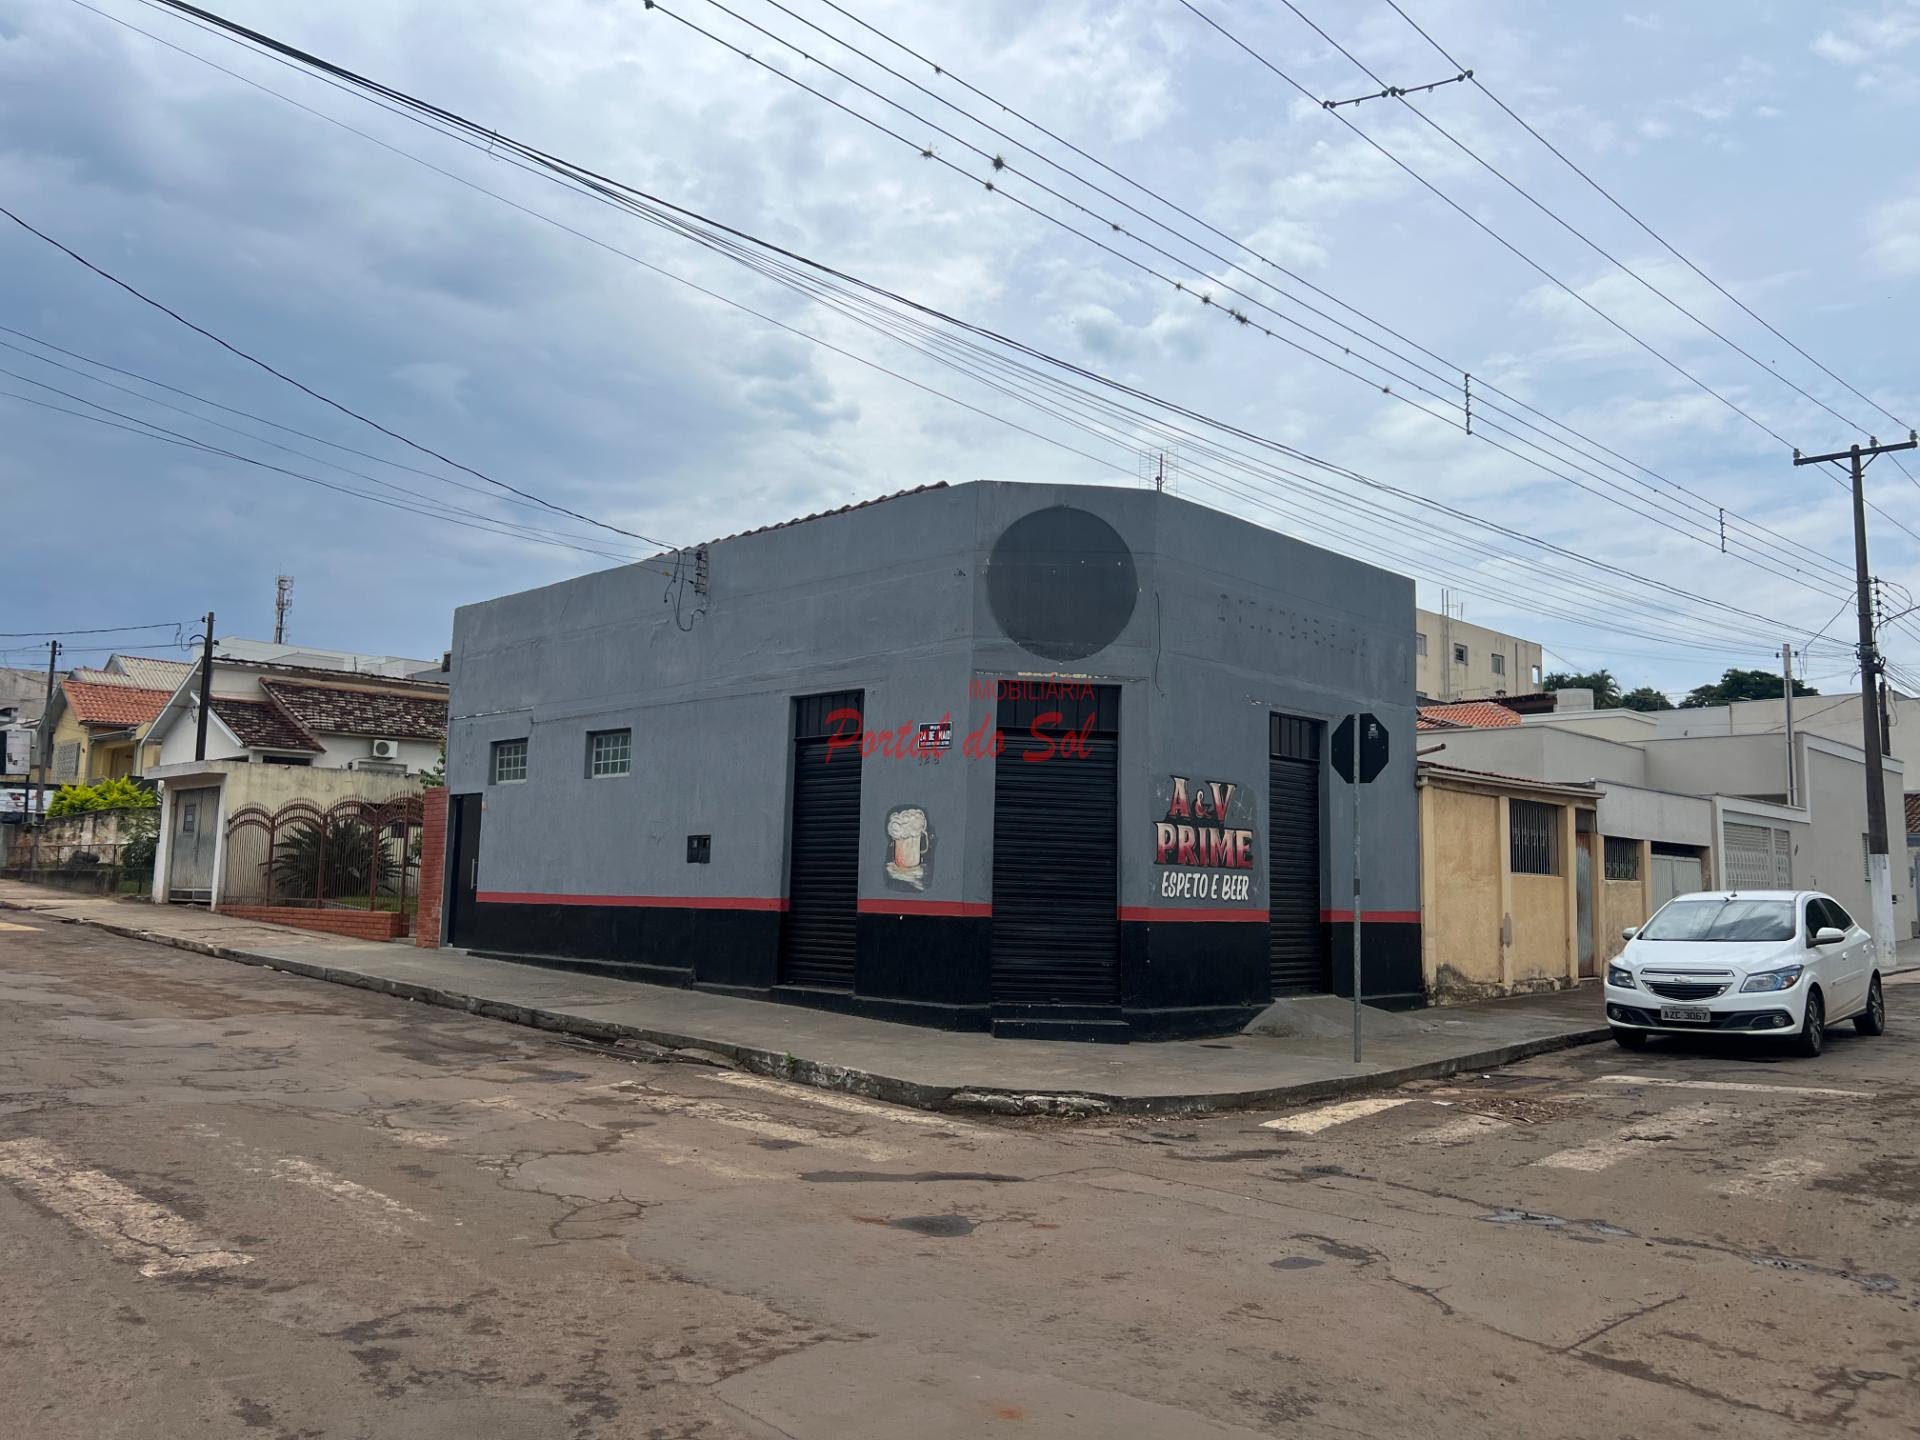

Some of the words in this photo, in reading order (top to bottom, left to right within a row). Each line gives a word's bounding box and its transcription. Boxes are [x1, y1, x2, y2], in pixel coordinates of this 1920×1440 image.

[928, 731, 935, 740] DE
[1155, 821, 1253, 869] PRIME
[1161, 871, 1208, 898] ESPETO
[1211, 873, 1219, 899] E
[1221, 875, 1249, 900] BEER
